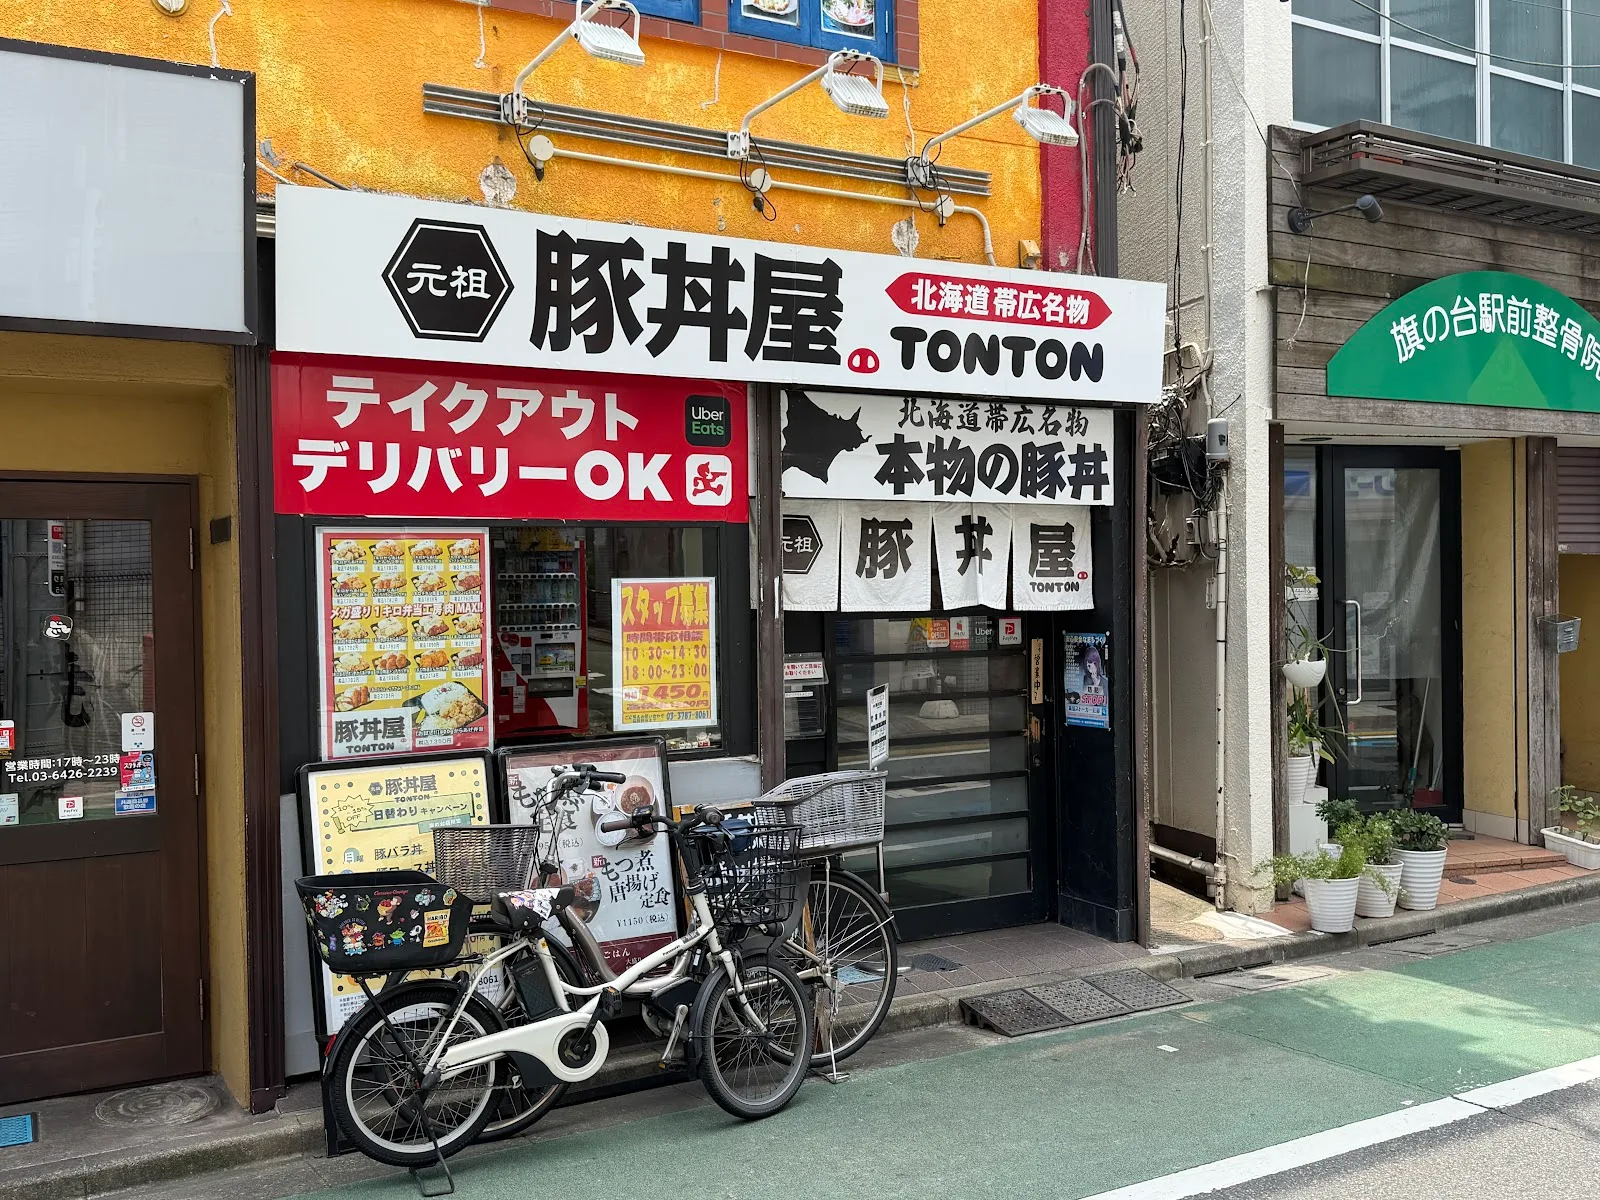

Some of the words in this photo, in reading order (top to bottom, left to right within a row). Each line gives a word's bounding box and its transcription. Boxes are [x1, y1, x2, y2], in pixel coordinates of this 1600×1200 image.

[406, 262, 492, 300] 元祖
[529, 229, 844, 366] 豚丼屋
[912, 279, 1090, 325] 北海道帯広名物
[890, 326, 1104, 383] TONTON
[326, 375, 639, 442] テイクアウト
[690, 406, 724, 422] Uber
[897, 398, 1090, 437] 北海道帯広名物
[691, 421, 725, 437] Eats
[292, 438, 673, 502] デリバリーOK
[873, 433, 1111, 501] 本物の豚丼
[1029, 581, 1080, 593] TONTON
[622, 584, 709, 627] スタッフ募集
[975, 628, 993, 636] Uber
[1081, 694, 1107, 706] STOP!
[334, 715, 406, 743] 豚丼屋
[346, 742, 395, 754] TONTON
[385, 775, 438, 796] 豚丼屋
[394, 794, 430, 803] TONTON
[346, 813, 361, 822] OFF
[374, 843, 424, 861] 豚バラ丼
[601, 849, 655, 882] もつ煮
[609, 872, 659, 903] 唐揚げ
[640, 887, 671, 909] 定食
[603, 948, 630, 959] ごはん
